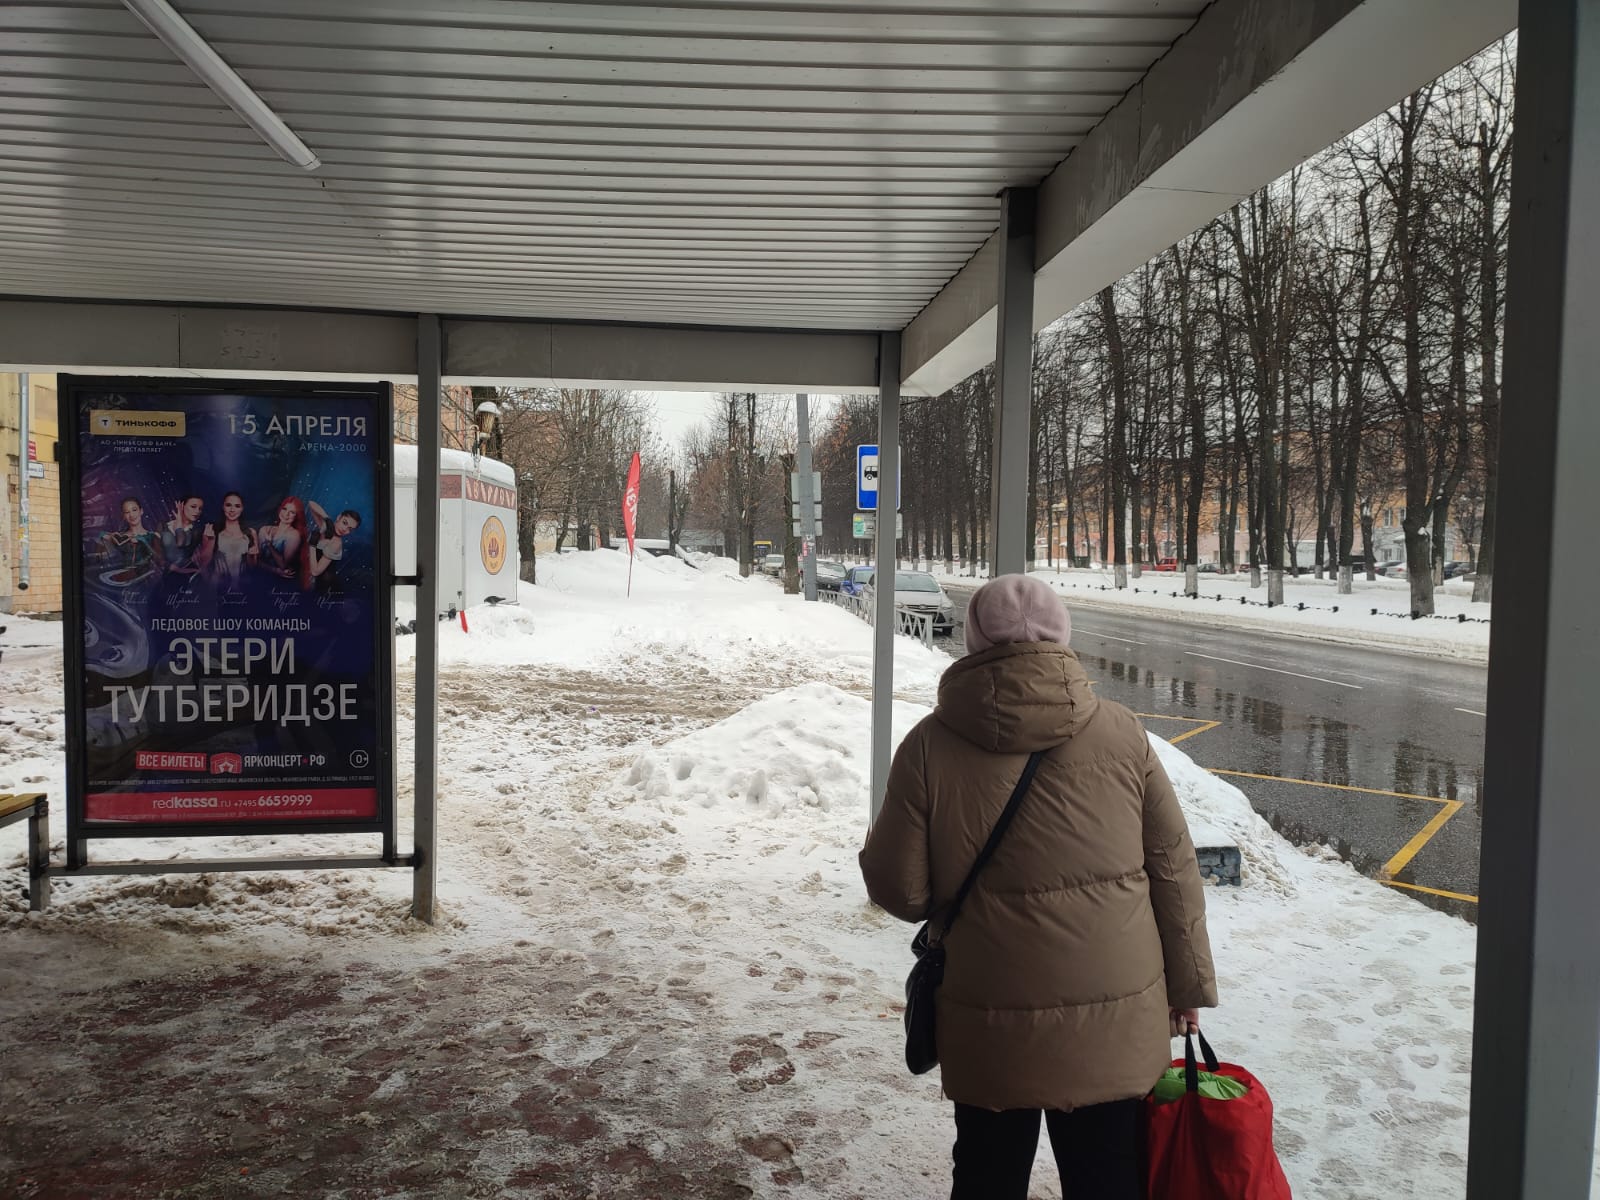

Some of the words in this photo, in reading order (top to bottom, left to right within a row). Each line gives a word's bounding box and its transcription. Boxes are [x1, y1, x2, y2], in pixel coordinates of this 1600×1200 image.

[115, 419, 177, 428] ТИНЬКОФФ
[228, 414, 257, 434] 15
[265, 414, 366, 436] АПРЕЛЯ
[299, 442, 366, 453] АРЕНА-2000
[151, 618, 209, 633] ЛЕДОВОЕ
[213, 618, 242, 631] ШОУ
[246, 618, 310, 632] КОМАНДЫ
[168, 637, 295, 675] ЭТЕРИ
[103, 683, 358, 727] ТУТБЕРИДЗЕ
[139, 754, 159, 767] ВСЕ
[160, 754, 204, 768] БИЛЕТЫ
